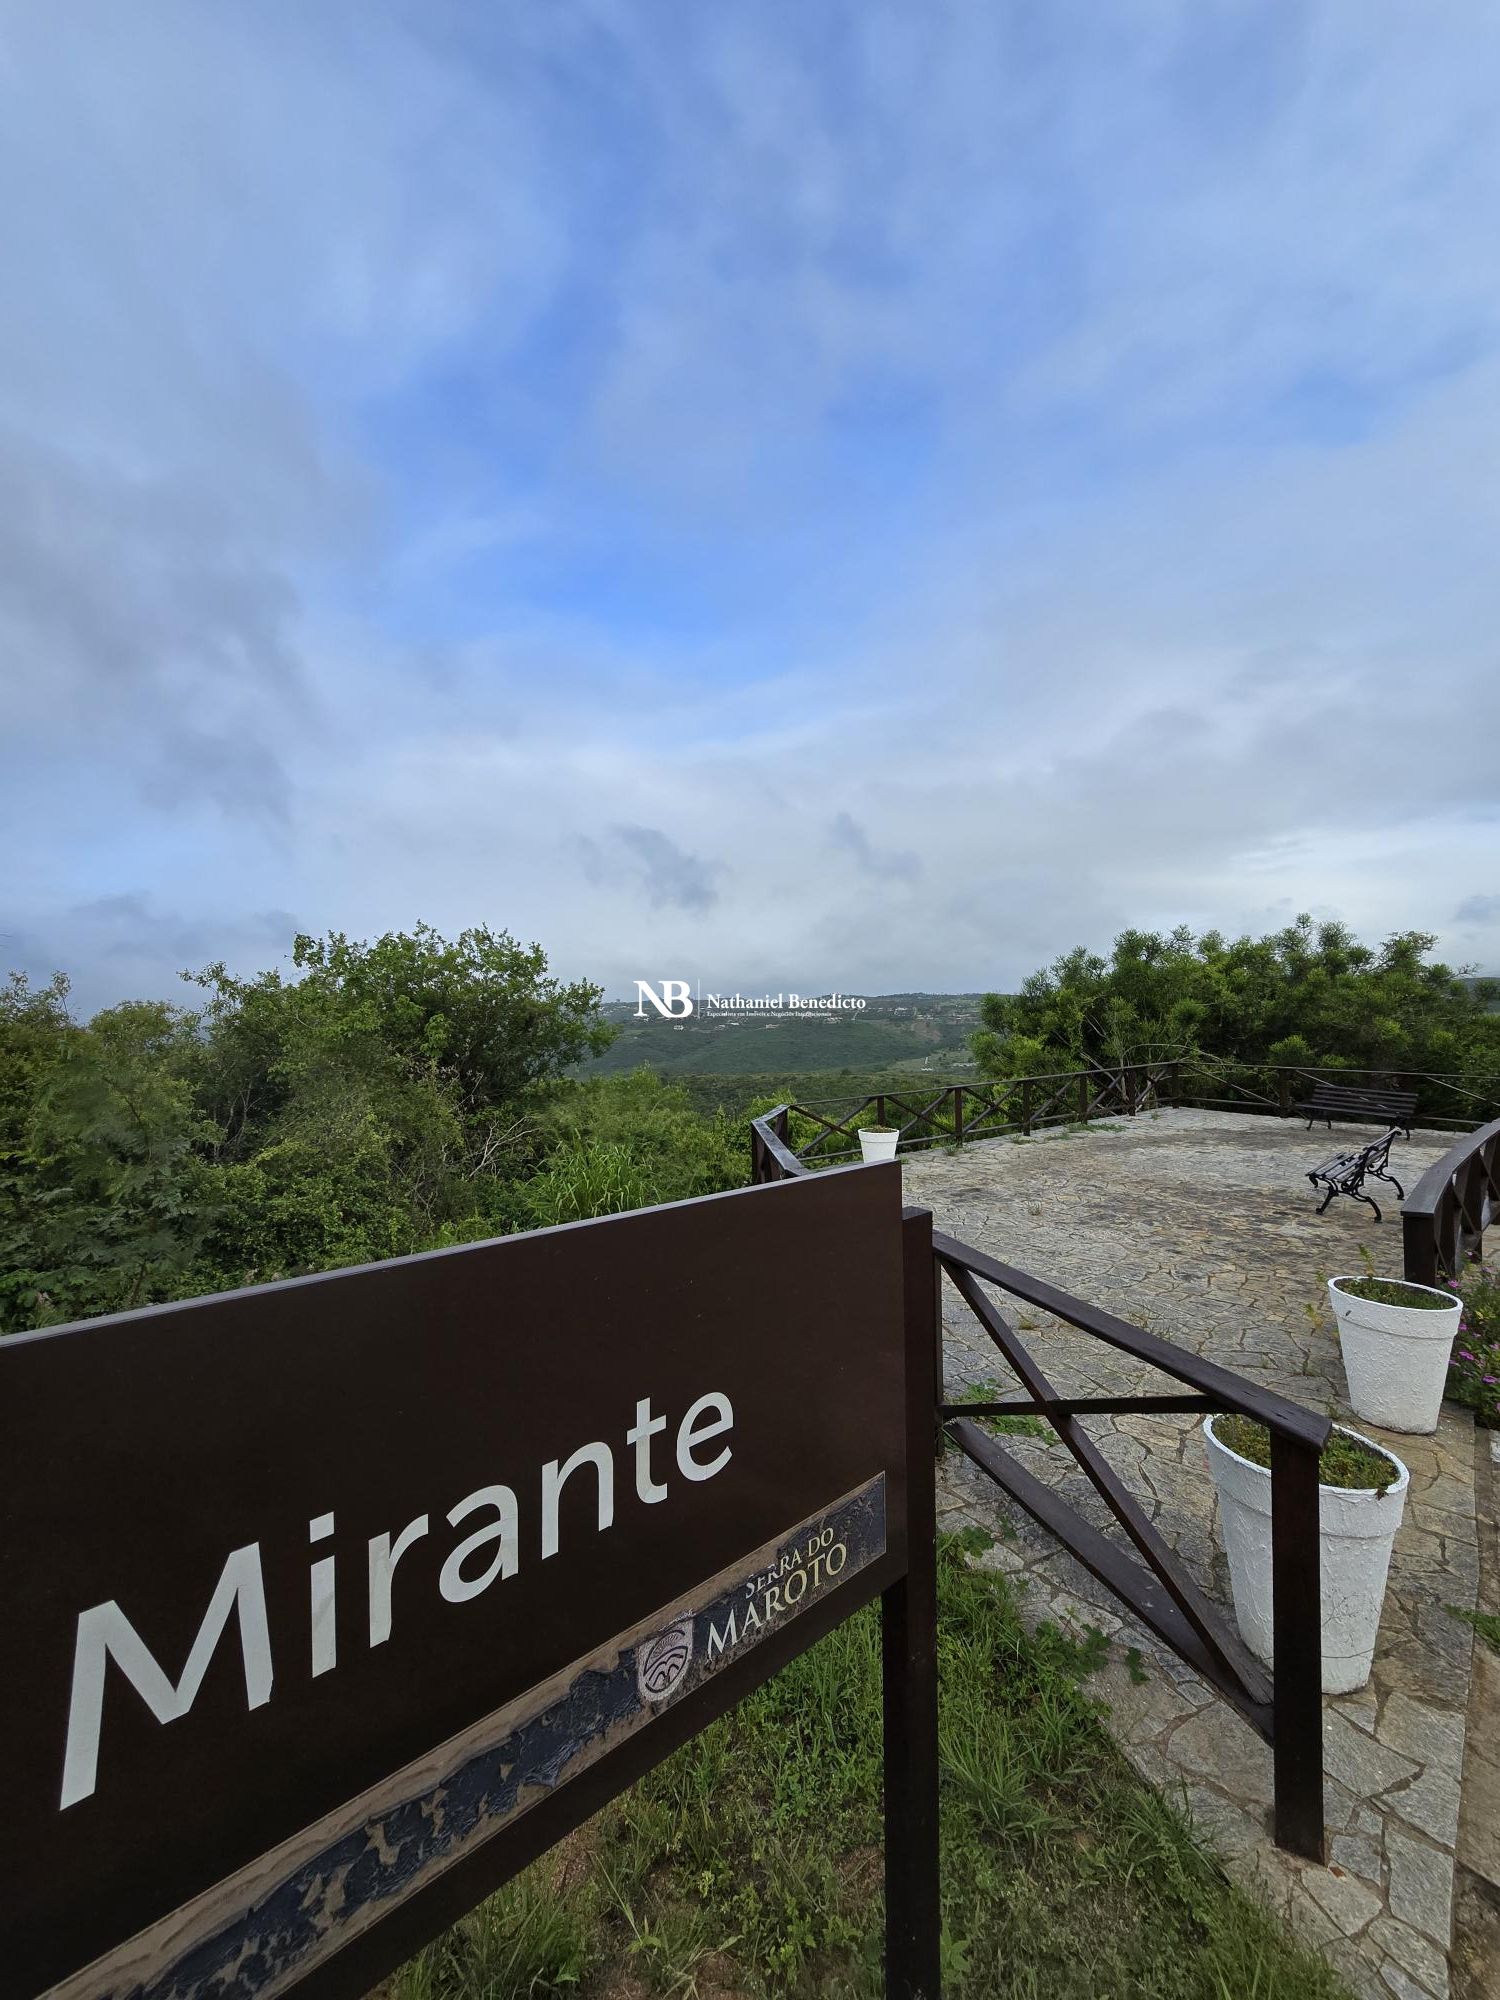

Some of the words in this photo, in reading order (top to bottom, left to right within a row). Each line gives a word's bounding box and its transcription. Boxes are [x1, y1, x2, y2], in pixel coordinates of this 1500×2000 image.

[60, 1391, 733, 1811] Mirante
[707, 1543, 847, 1660] MAROTO
[746, 1548, 802, 1599] SERRA
[808, 1527, 834, 1557] DO
